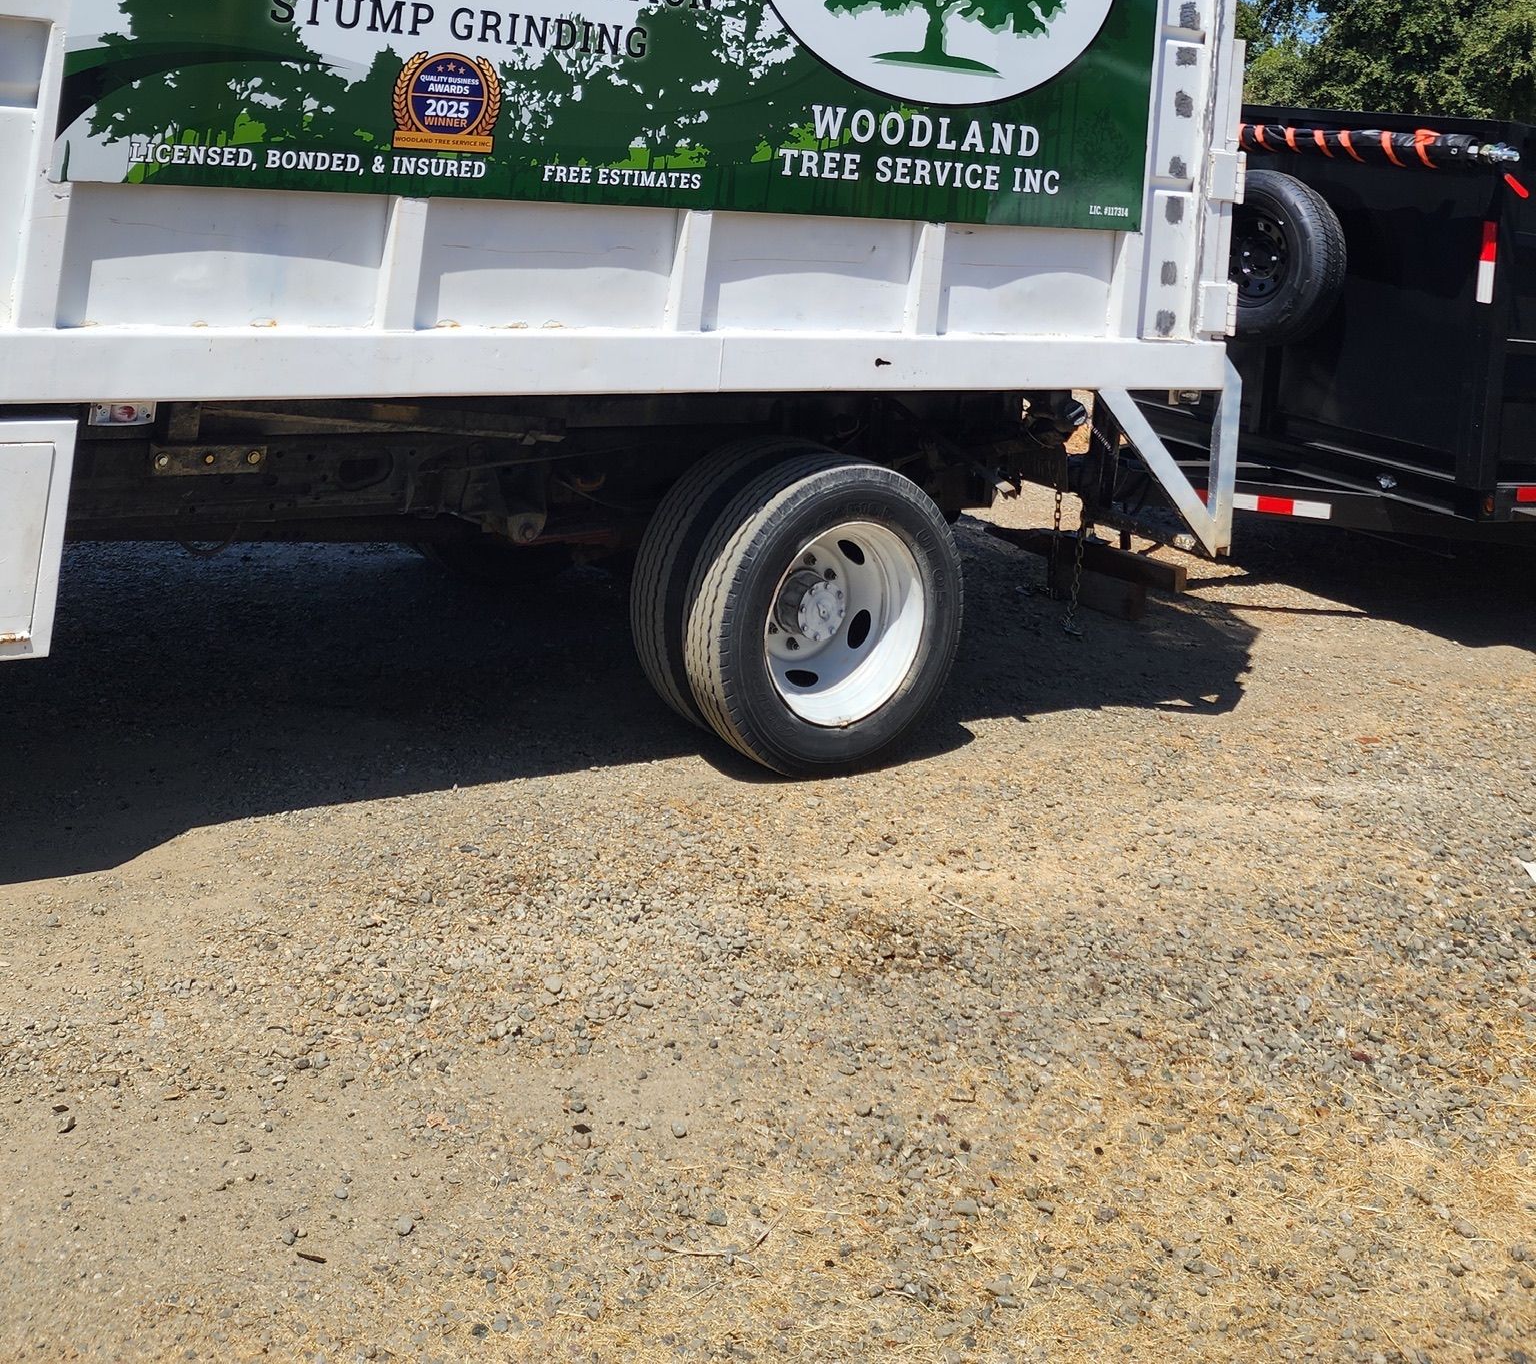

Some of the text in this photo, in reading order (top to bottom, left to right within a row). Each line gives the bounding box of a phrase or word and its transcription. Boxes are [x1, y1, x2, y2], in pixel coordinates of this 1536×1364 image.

[449, 8, 649, 58] GRINDING
[420, 74, 479, 85] QUALITY BUSINESS
[428, 83, 469, 95] AWARDS
[424, 99, 469, 119] 2025
[424, 116, 468, 128] WINNER
[811, 104, 1040, 158] WOODLAND
[395, 136, 433, 144] WOODLAND
[451, 139, 477, 147] SERVICE
[129, 142, 486, 178] LICENSED, BONDED, & INSURED
[542, 165, 702, 190] FREE ESTIMATES
[779, 148, 1060, 195] TREE SERVICE INC
[1089, 205, 1103, 215] LIC.
